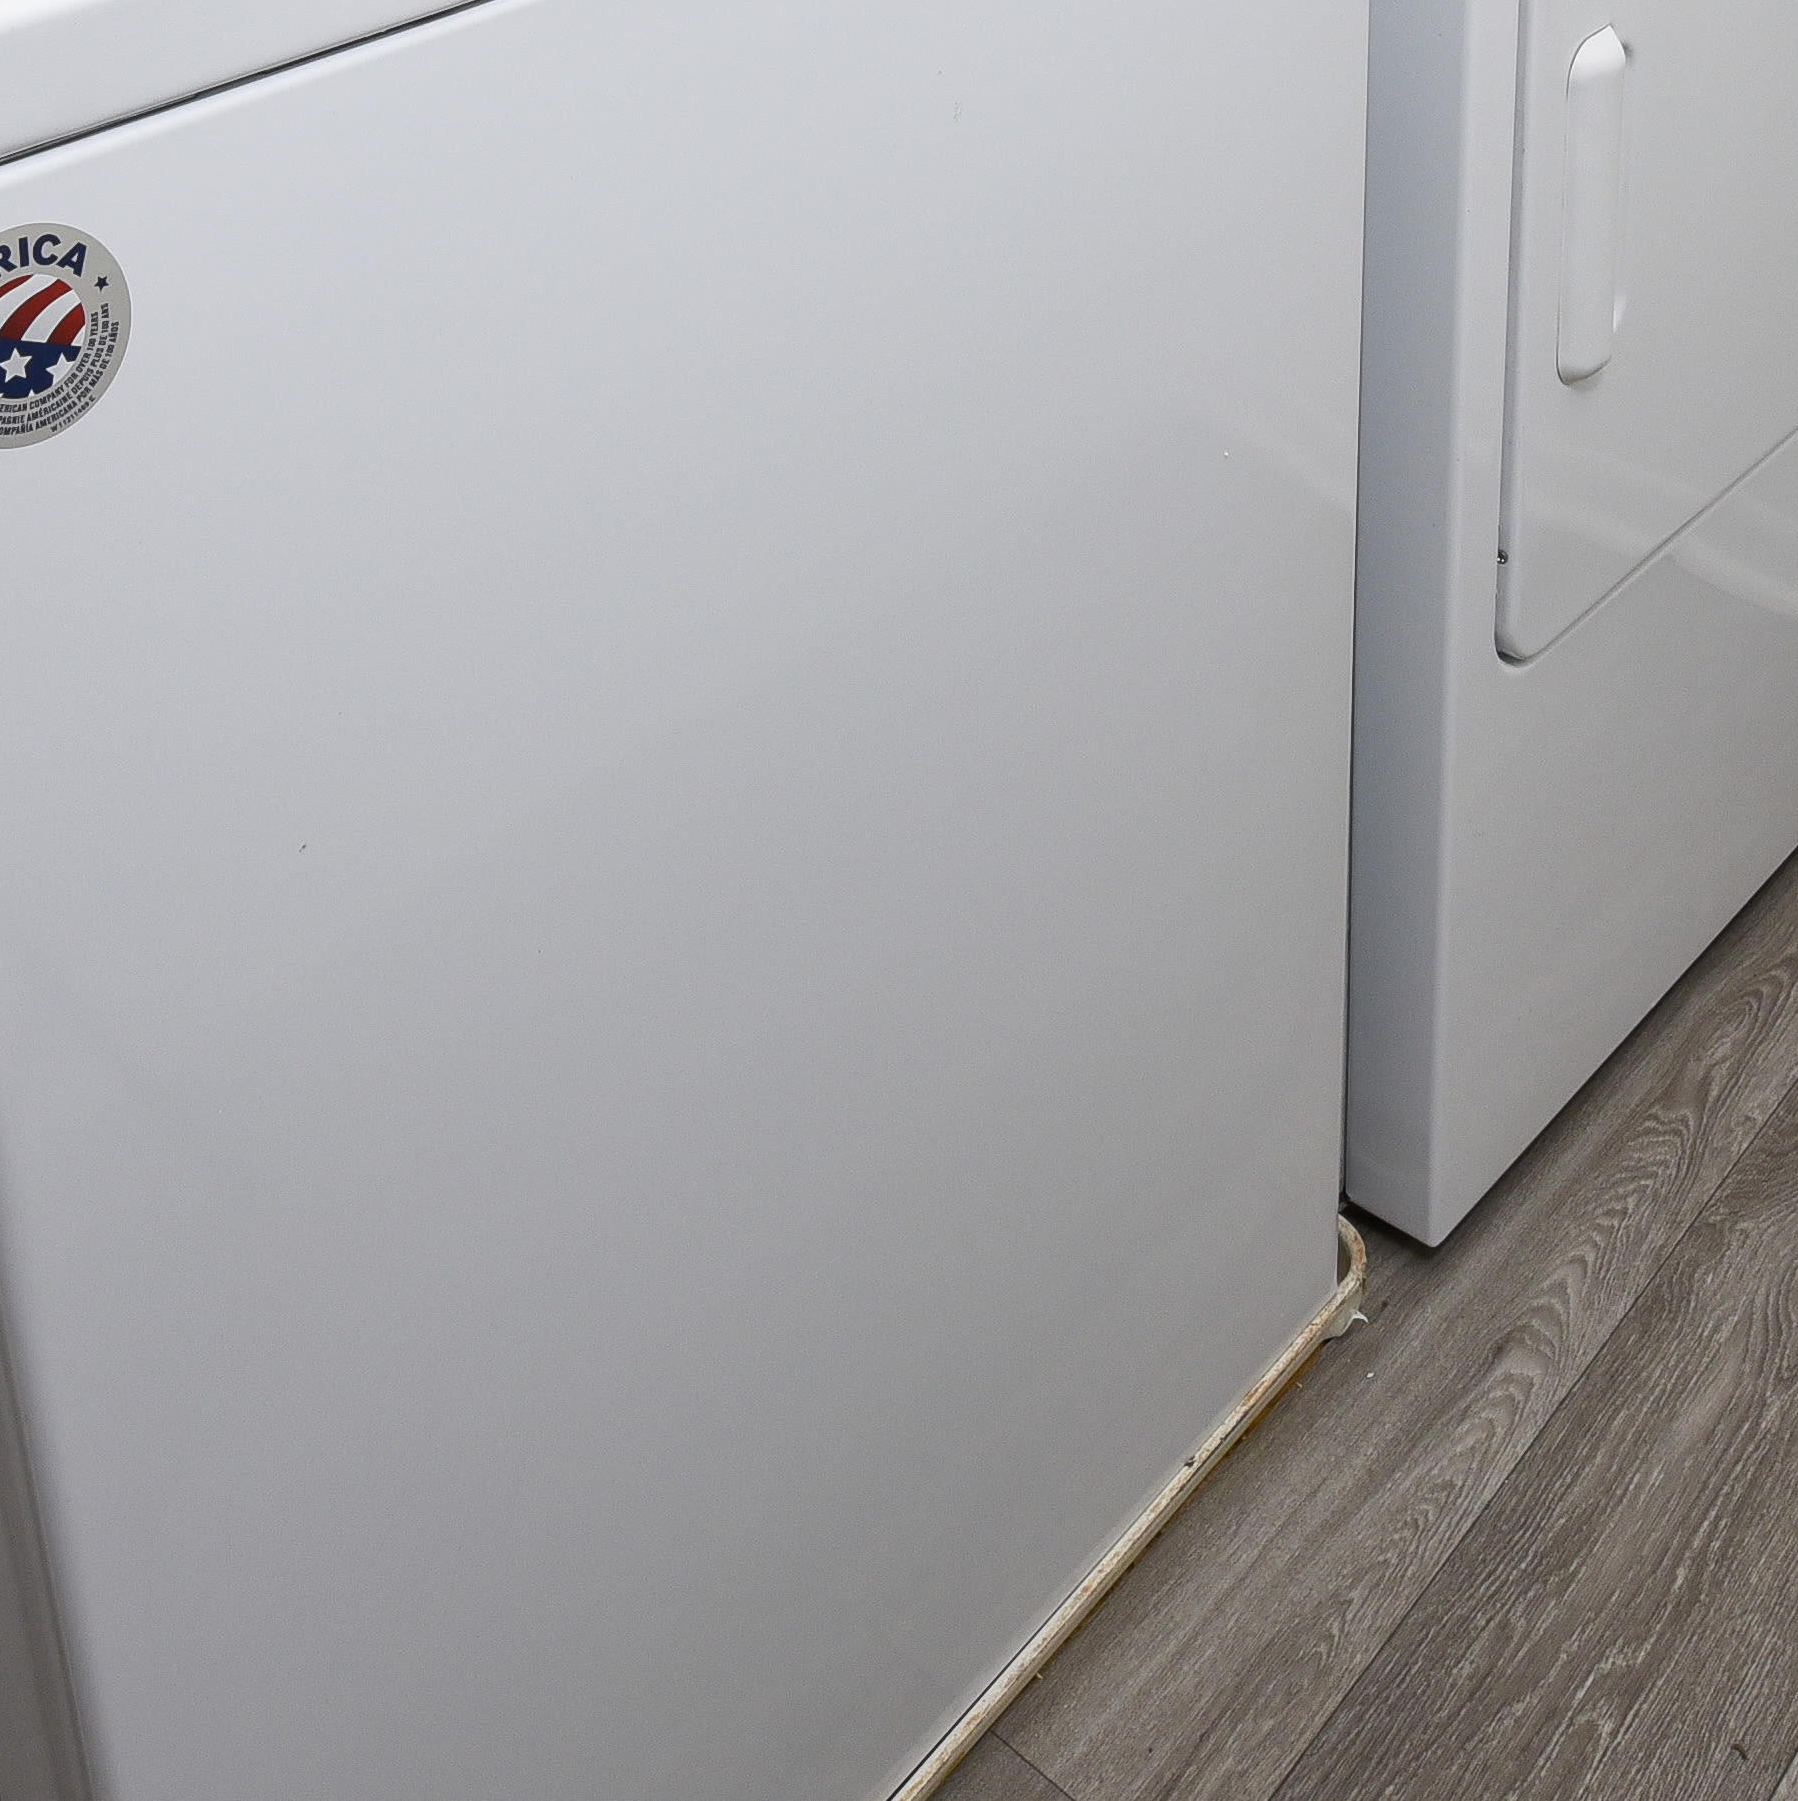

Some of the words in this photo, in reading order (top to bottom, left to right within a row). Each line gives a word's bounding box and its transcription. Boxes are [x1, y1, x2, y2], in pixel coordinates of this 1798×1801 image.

[101, 302, 109, 318] ANS
[90, 311, 99, 337] YEARS
[101, 320, 109, 333] 100
[86, 338, 96, 351] 100
[98, 335, 107, 346] DE
[76, 352, 91, 373] OVER
[90, 347, 104, 367] PLUS
[35, 400, 78, 430] AMERICANA
[76, 386, 91, 402] POR
[99, 359, 110, 370] DE
[105, 344, 115, 357] 100
[64, 372, 78, 388] FOR
[70, 367, 94, 395] DEPUIS
[29, 384, 65, 409] COMPANY
